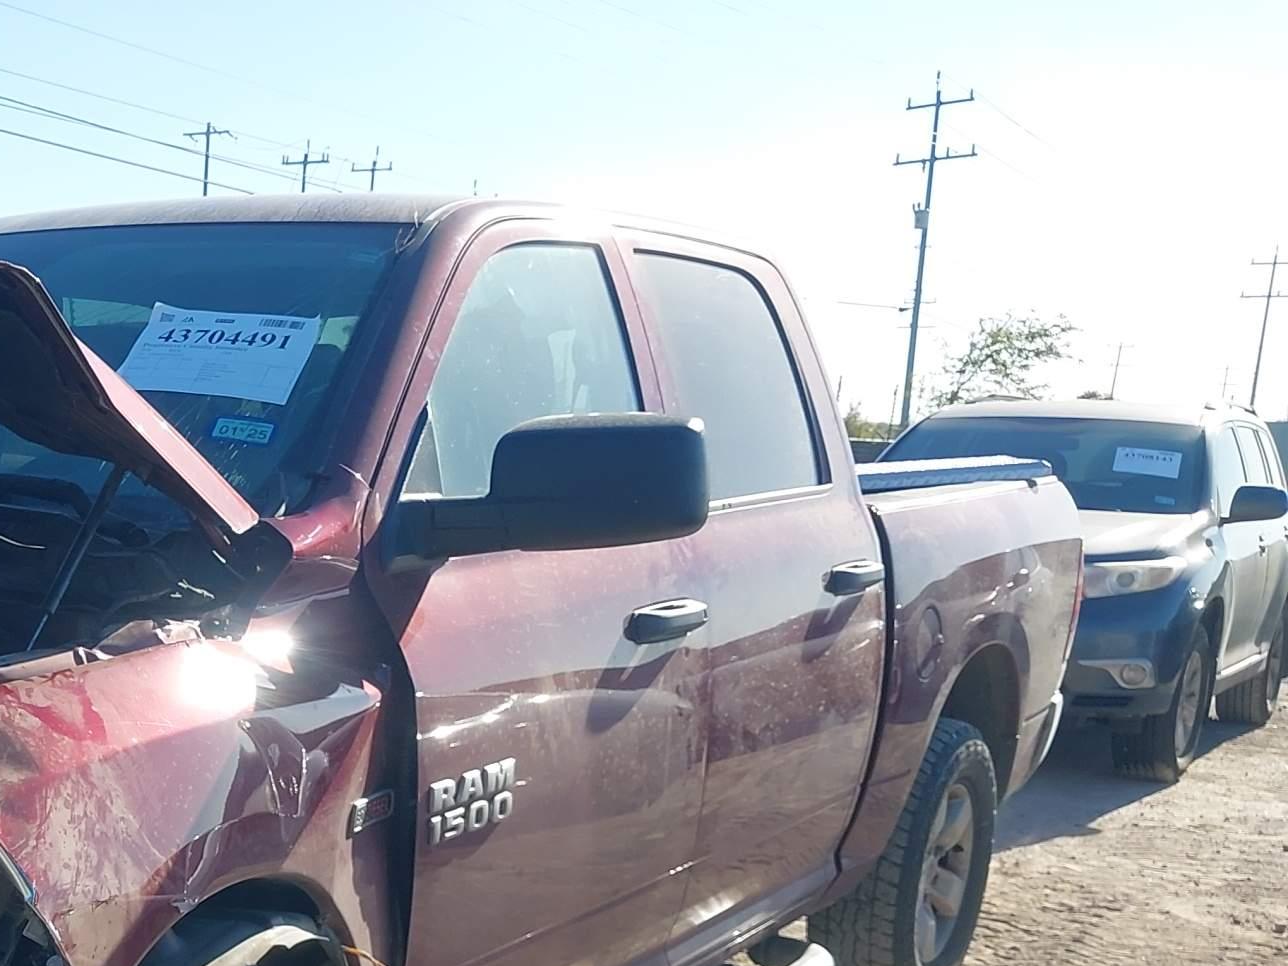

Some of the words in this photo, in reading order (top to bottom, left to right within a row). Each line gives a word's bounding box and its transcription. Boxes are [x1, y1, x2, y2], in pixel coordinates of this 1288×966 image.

[158, 327, 292, 350] 43704491
[218, 424, 238, 436] 01
[247, 428, 268, 440] 25
[429, 757, 516, 812] RAM
[429, 790, 513, 846] 1500
